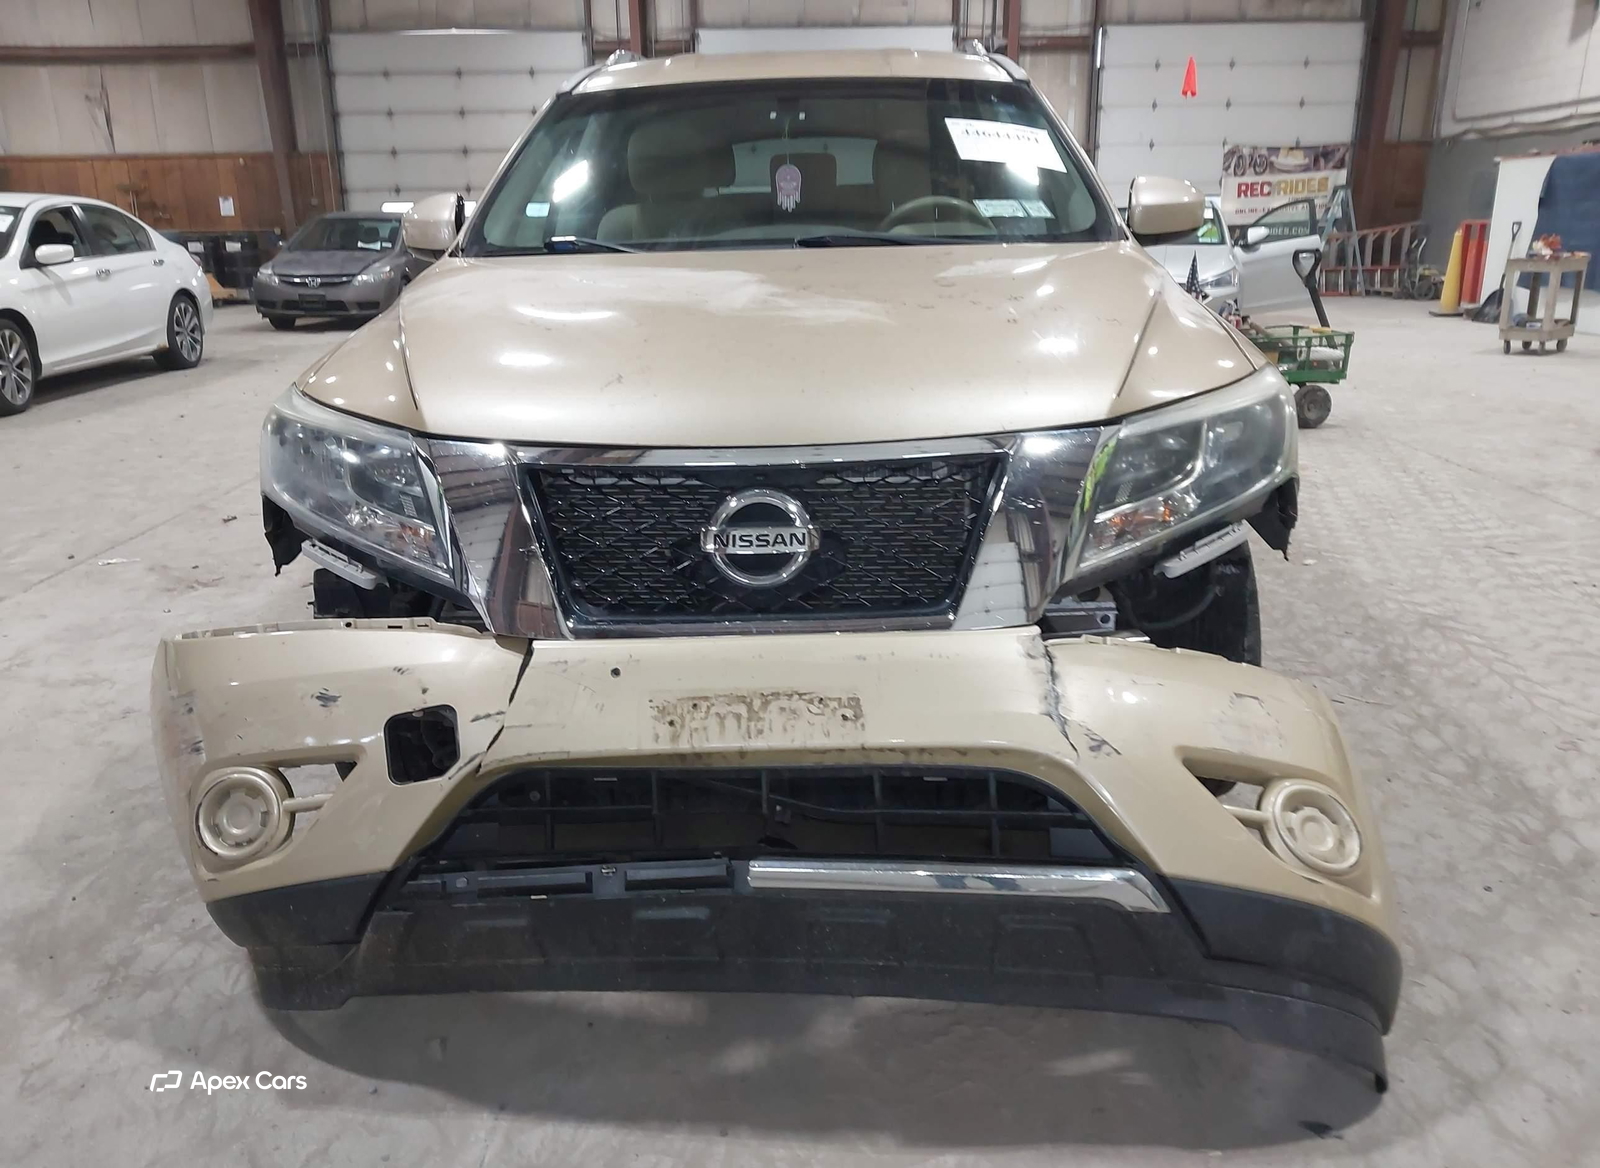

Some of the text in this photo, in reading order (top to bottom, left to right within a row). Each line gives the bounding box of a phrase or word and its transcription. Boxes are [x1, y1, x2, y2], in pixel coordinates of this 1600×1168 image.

[1237, 177, 1329, 198] REC RIDES
[713, 532, 806, 548] NISSAN
